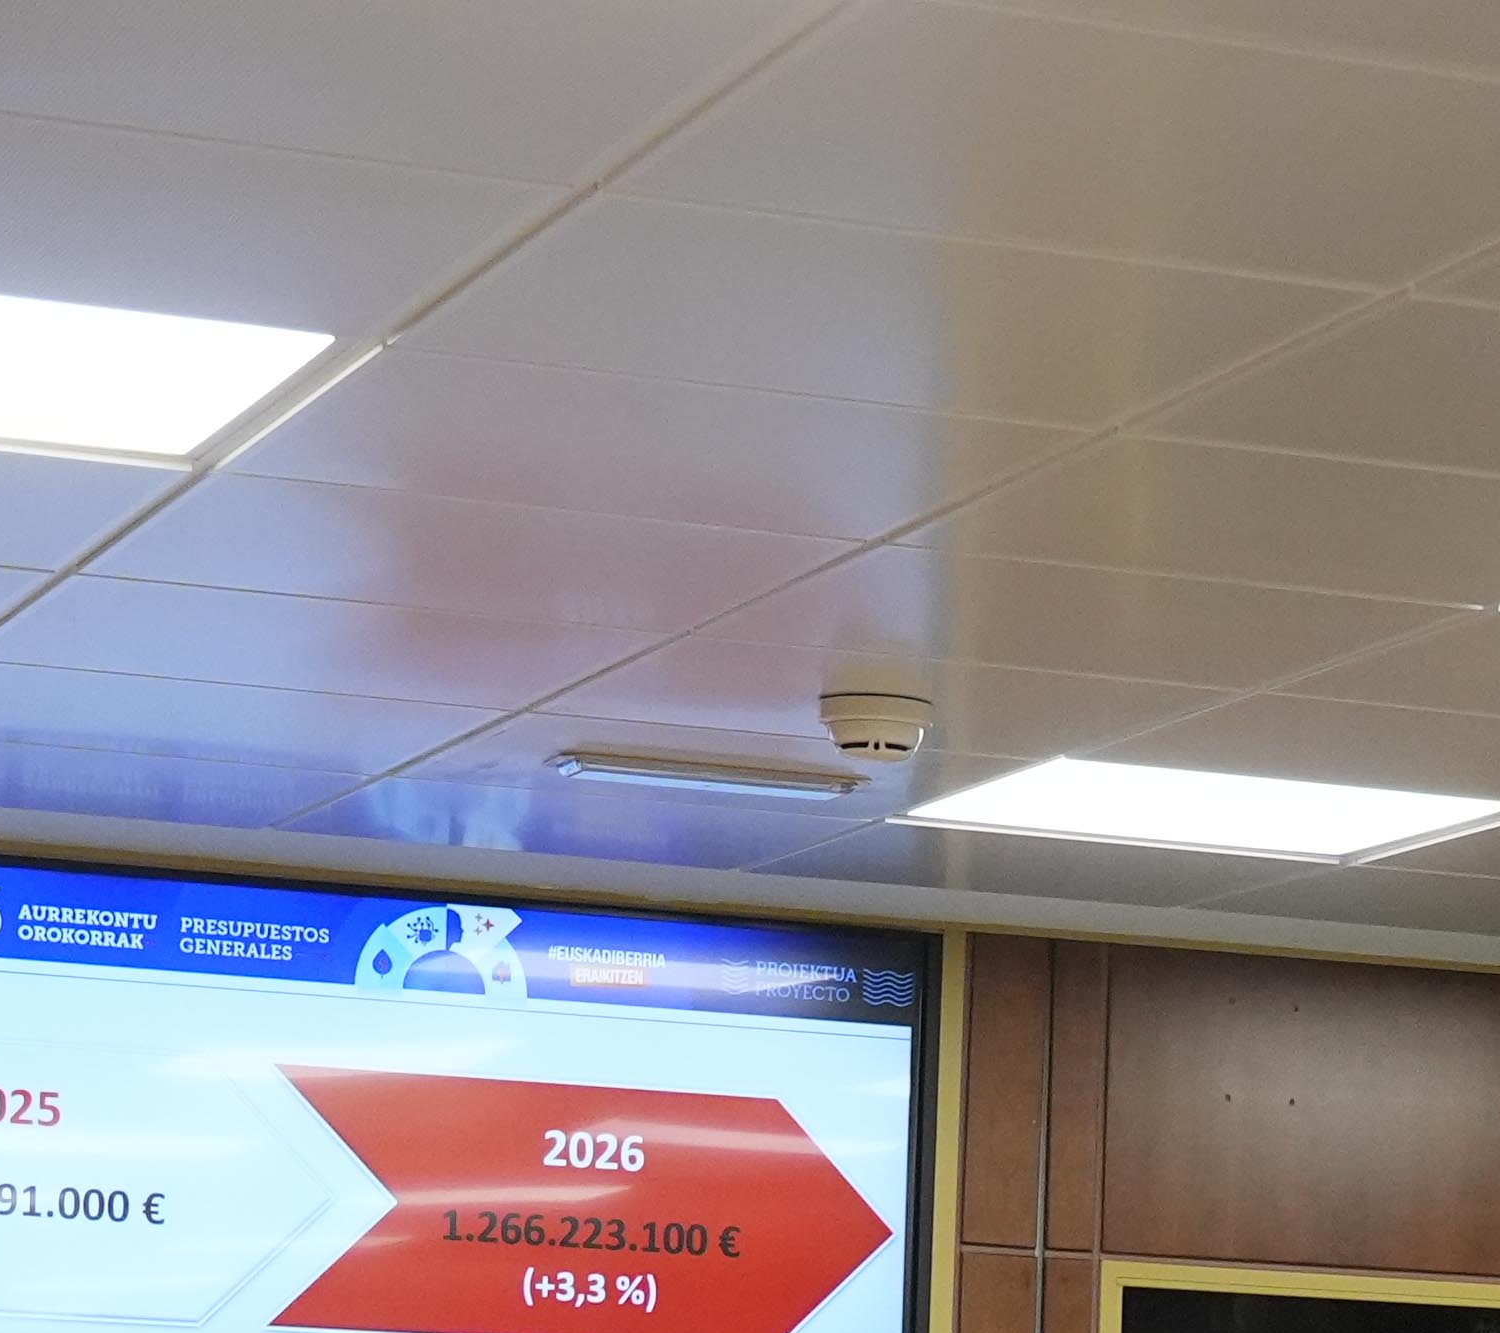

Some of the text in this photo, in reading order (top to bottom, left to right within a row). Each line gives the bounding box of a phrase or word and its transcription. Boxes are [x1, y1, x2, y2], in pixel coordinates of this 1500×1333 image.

[17, 904, 159, 930] AURREKONTU
[180, 917, 330, 943] PRESUPUESTOS
[17, 925, 145, 950] OROKORRAK
[179, 937, 293, 961] GENERALES
[548, 945, 666, 969] #EUSKADIBERRIA
[755, 960, 858, 984] PROIEKTUA
[755, 983, 851, 1002] PROYECTO
[542, 1129, 645, 1172] 2026
[142, 1193, 165, 1225] €
[442, 1209, 741, 1258] 1.266.223.100 €
[523, 1267, 658, 1313] (+3,3 %)
